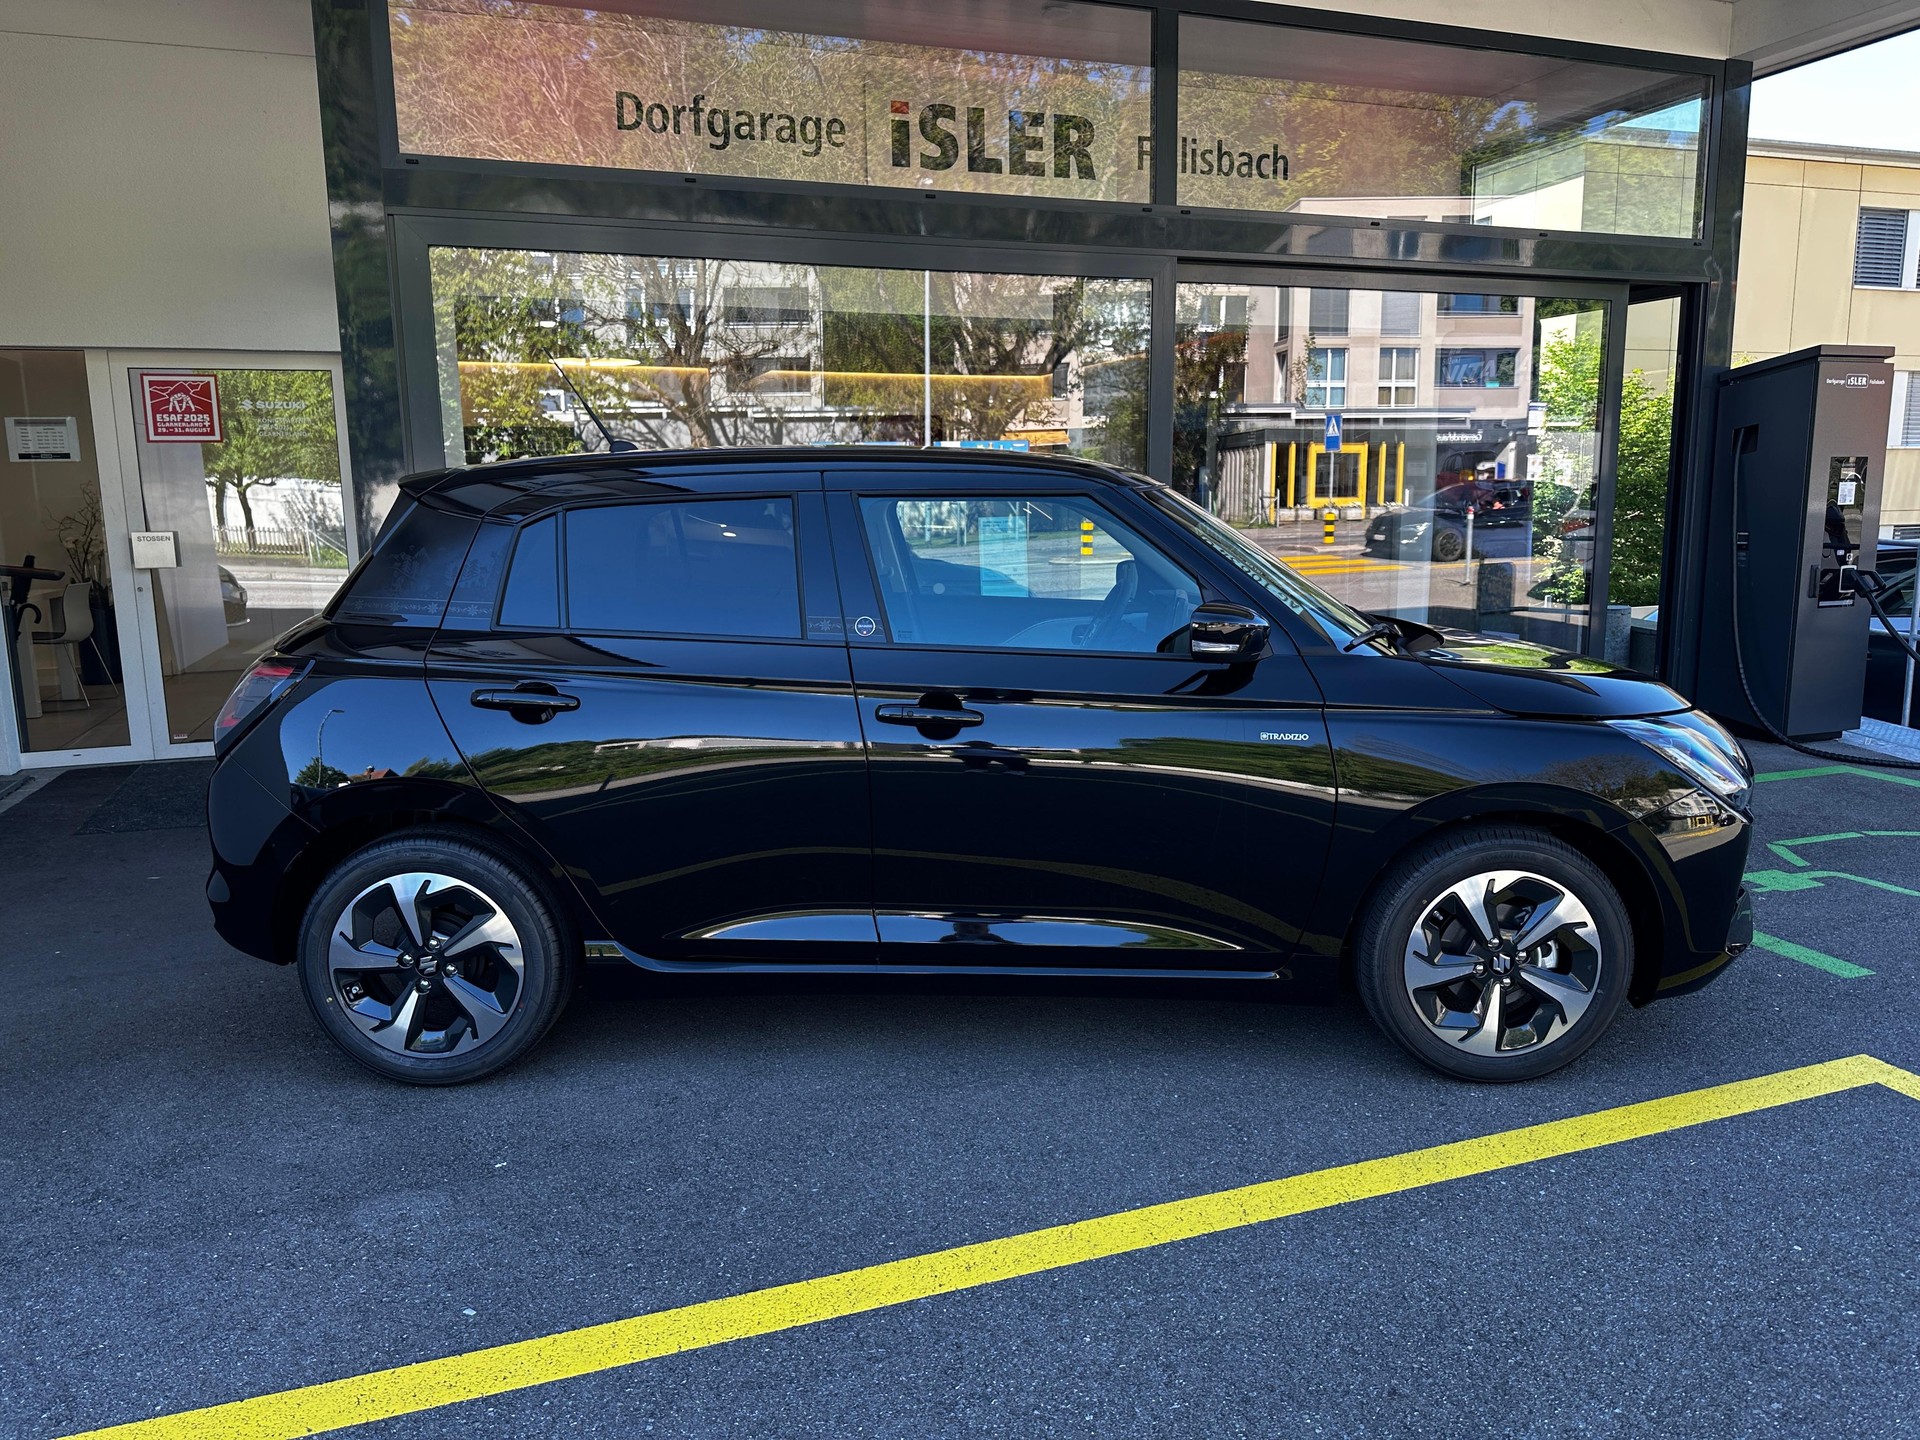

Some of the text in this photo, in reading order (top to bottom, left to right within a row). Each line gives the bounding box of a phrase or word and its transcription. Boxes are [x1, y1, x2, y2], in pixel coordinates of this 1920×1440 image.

[615, 91, 846, 157] Dorfgarage
[890, 101, 1096, 181] iSLER
[256, 400, 306, 409] SUZUKI
[156, 414, 183, 422] ESAF
